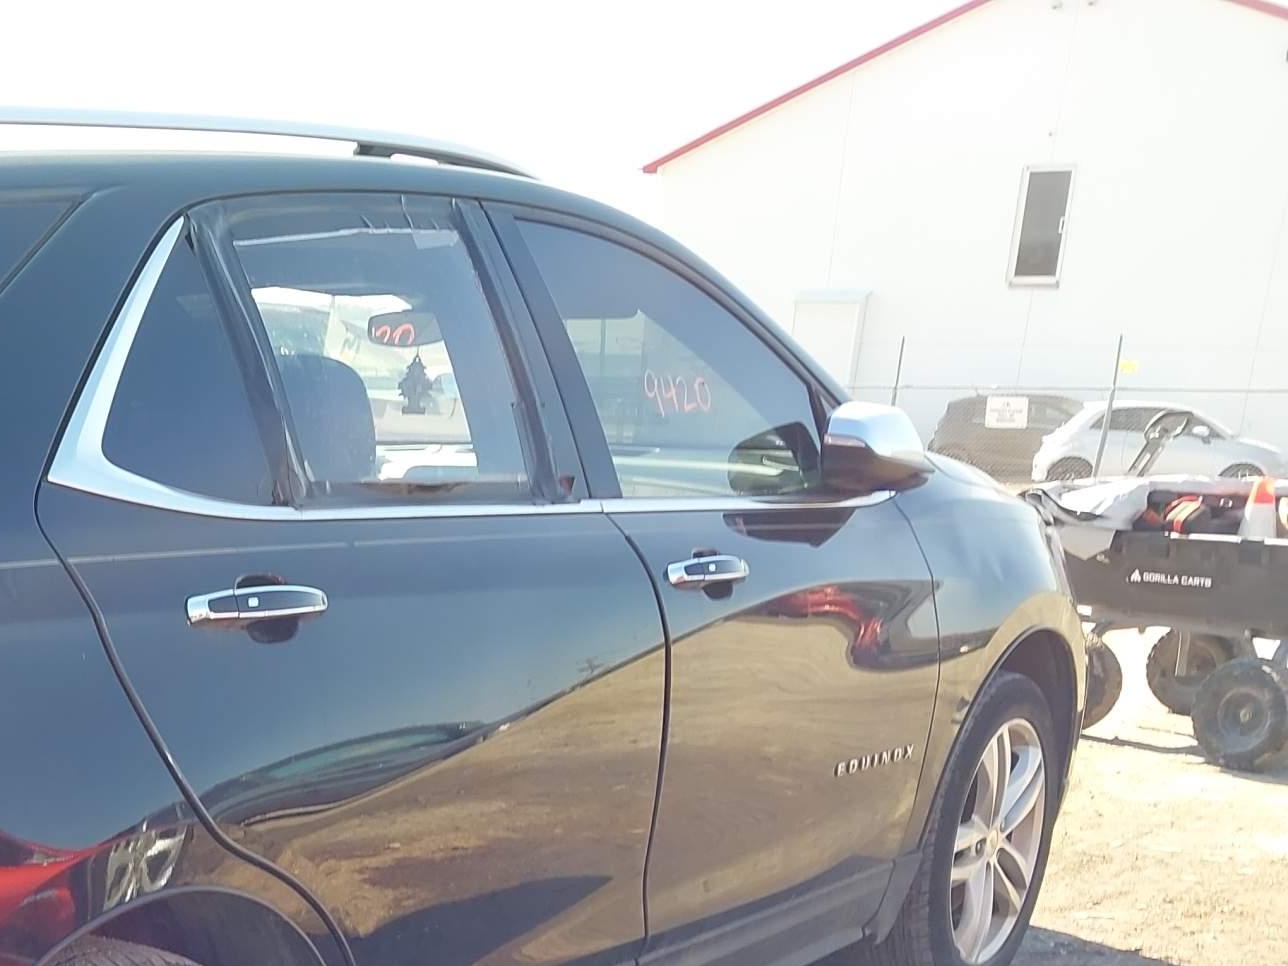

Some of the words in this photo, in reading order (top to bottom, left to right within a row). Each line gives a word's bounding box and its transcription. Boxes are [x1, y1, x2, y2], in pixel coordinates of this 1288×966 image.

[644, 368, 712, 418] 9420
[1142, 571, 1179, 585] GORILLA
[1180, 575, 1212, 589] CARTS
[833, 743, 914, 777] EQUINOX
